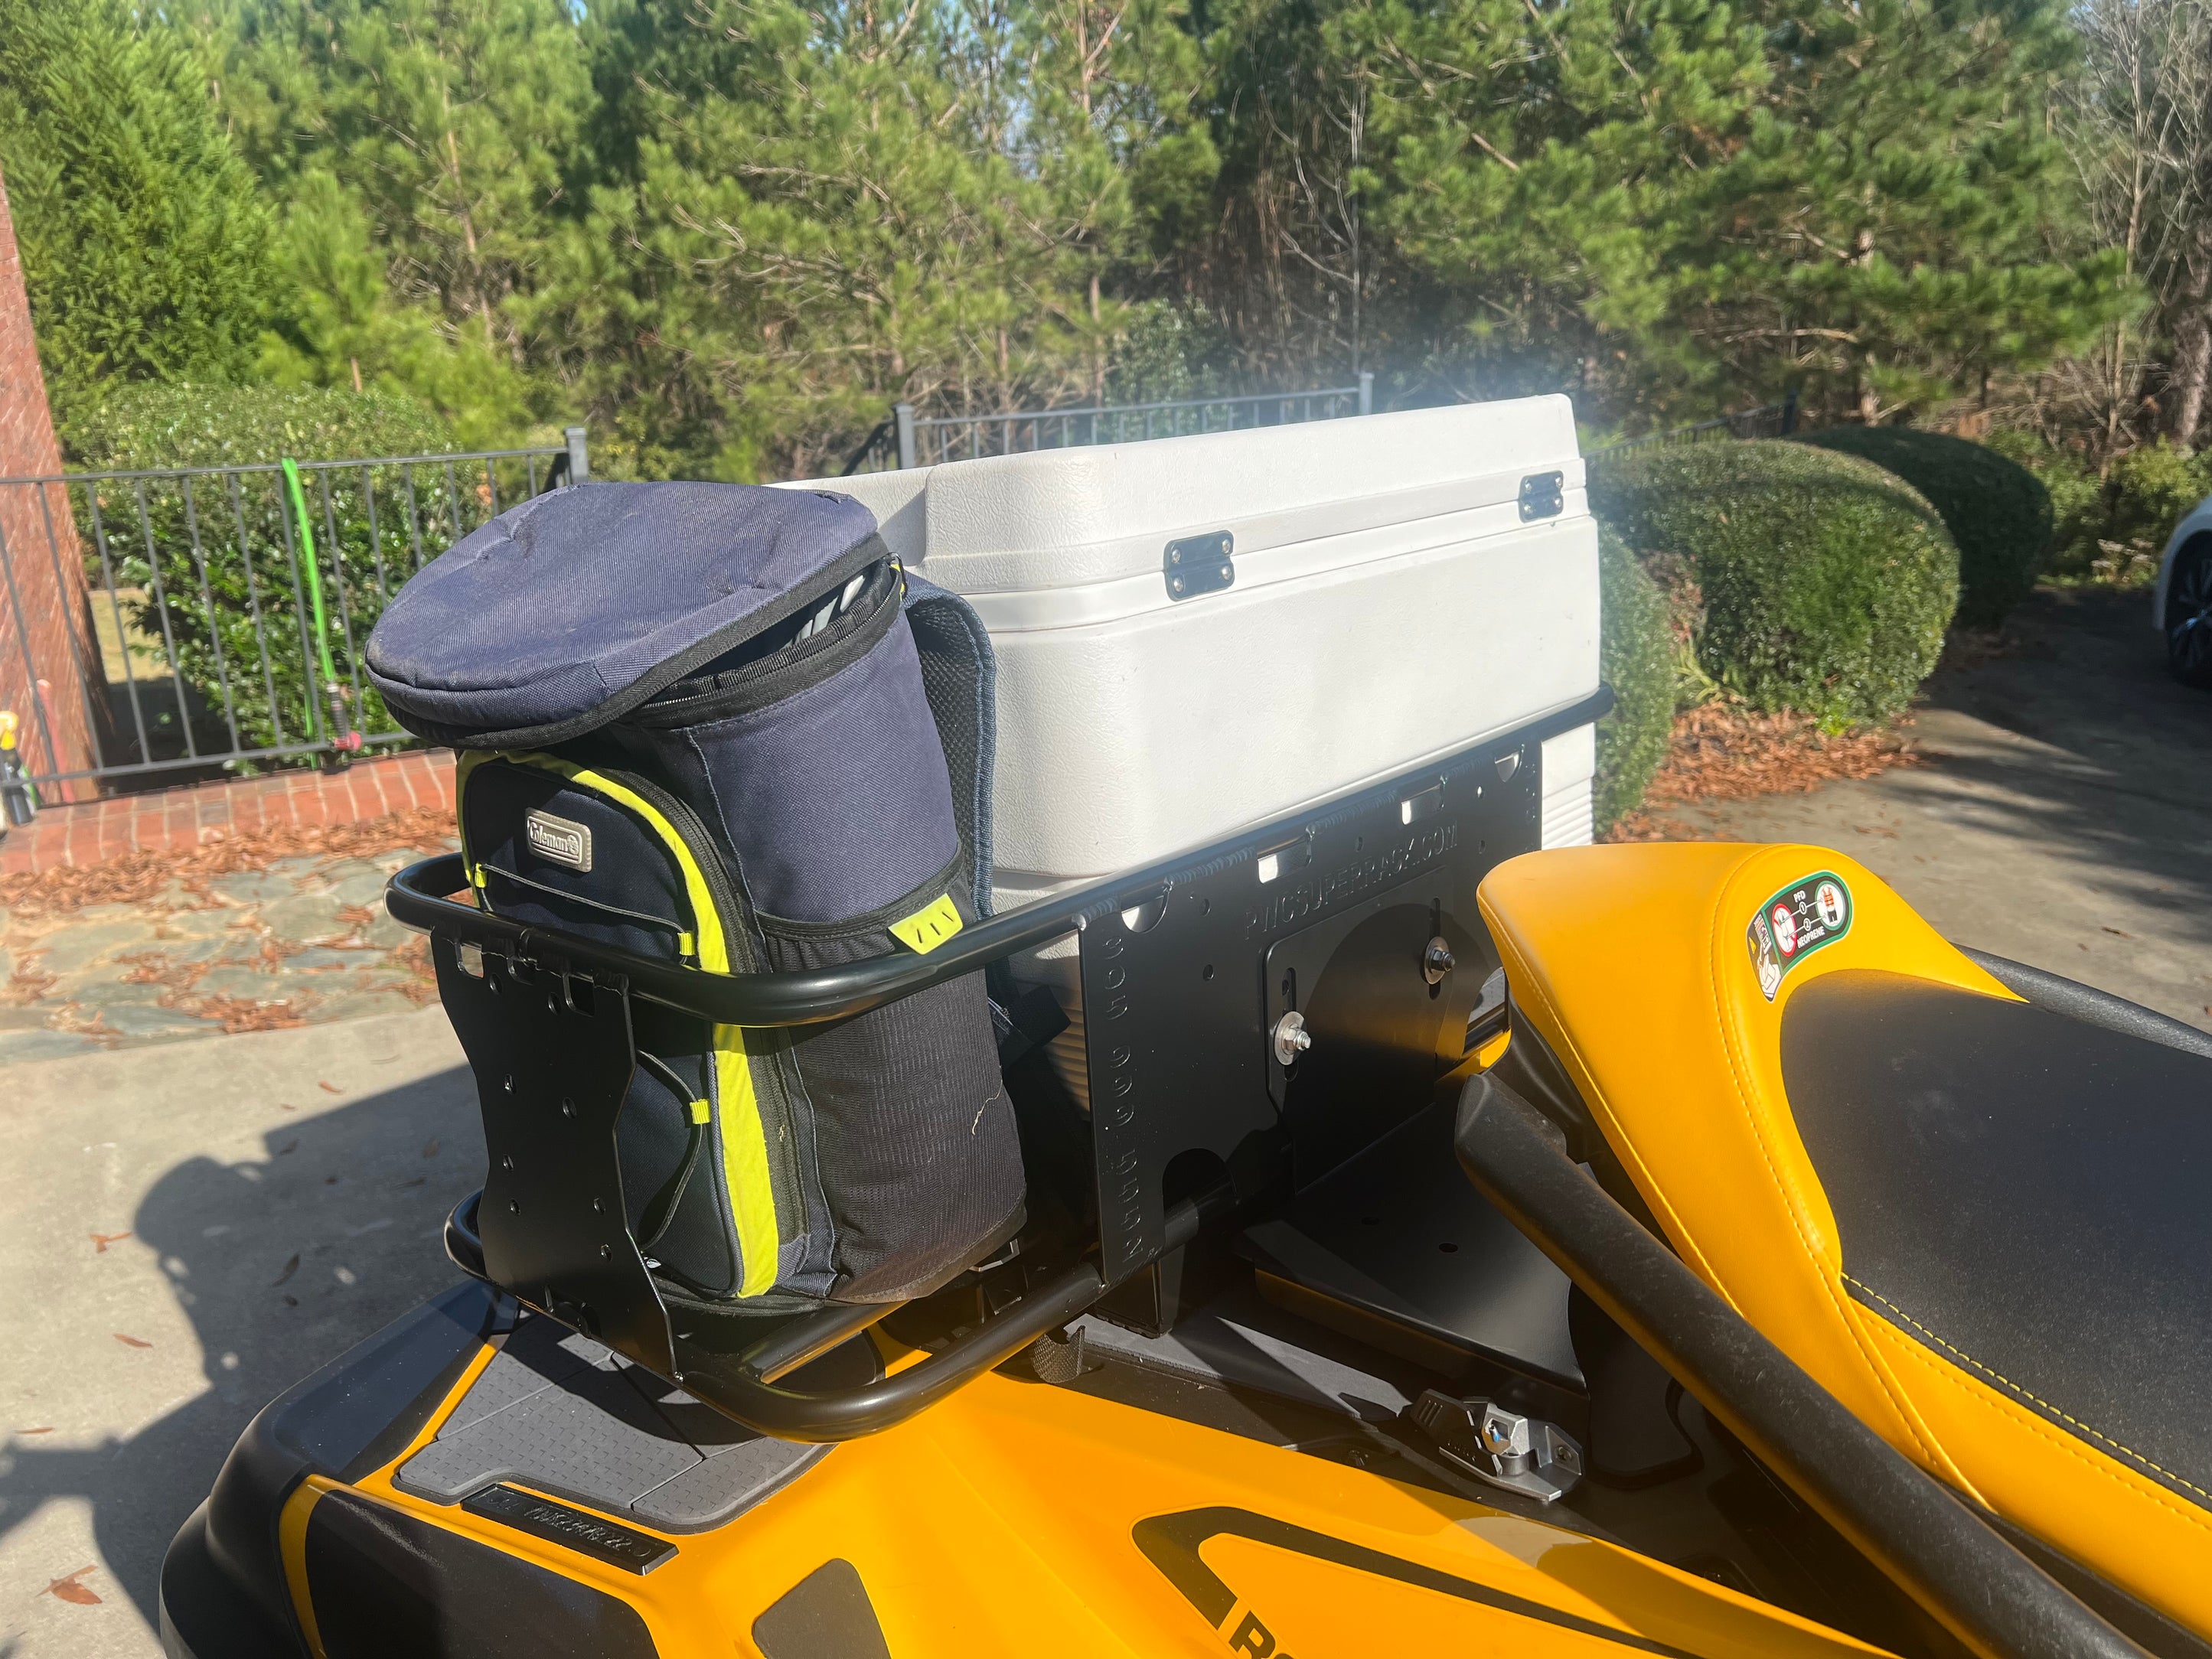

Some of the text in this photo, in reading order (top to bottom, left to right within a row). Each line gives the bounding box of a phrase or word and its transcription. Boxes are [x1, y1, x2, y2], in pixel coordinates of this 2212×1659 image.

[529, 822, 569, 852] Coleman
[1793, 890, 1806, 903] PFD
[1797, 925, 1825, 949] NEOPRENE
[1228, 1610, 1294, 1659] R
